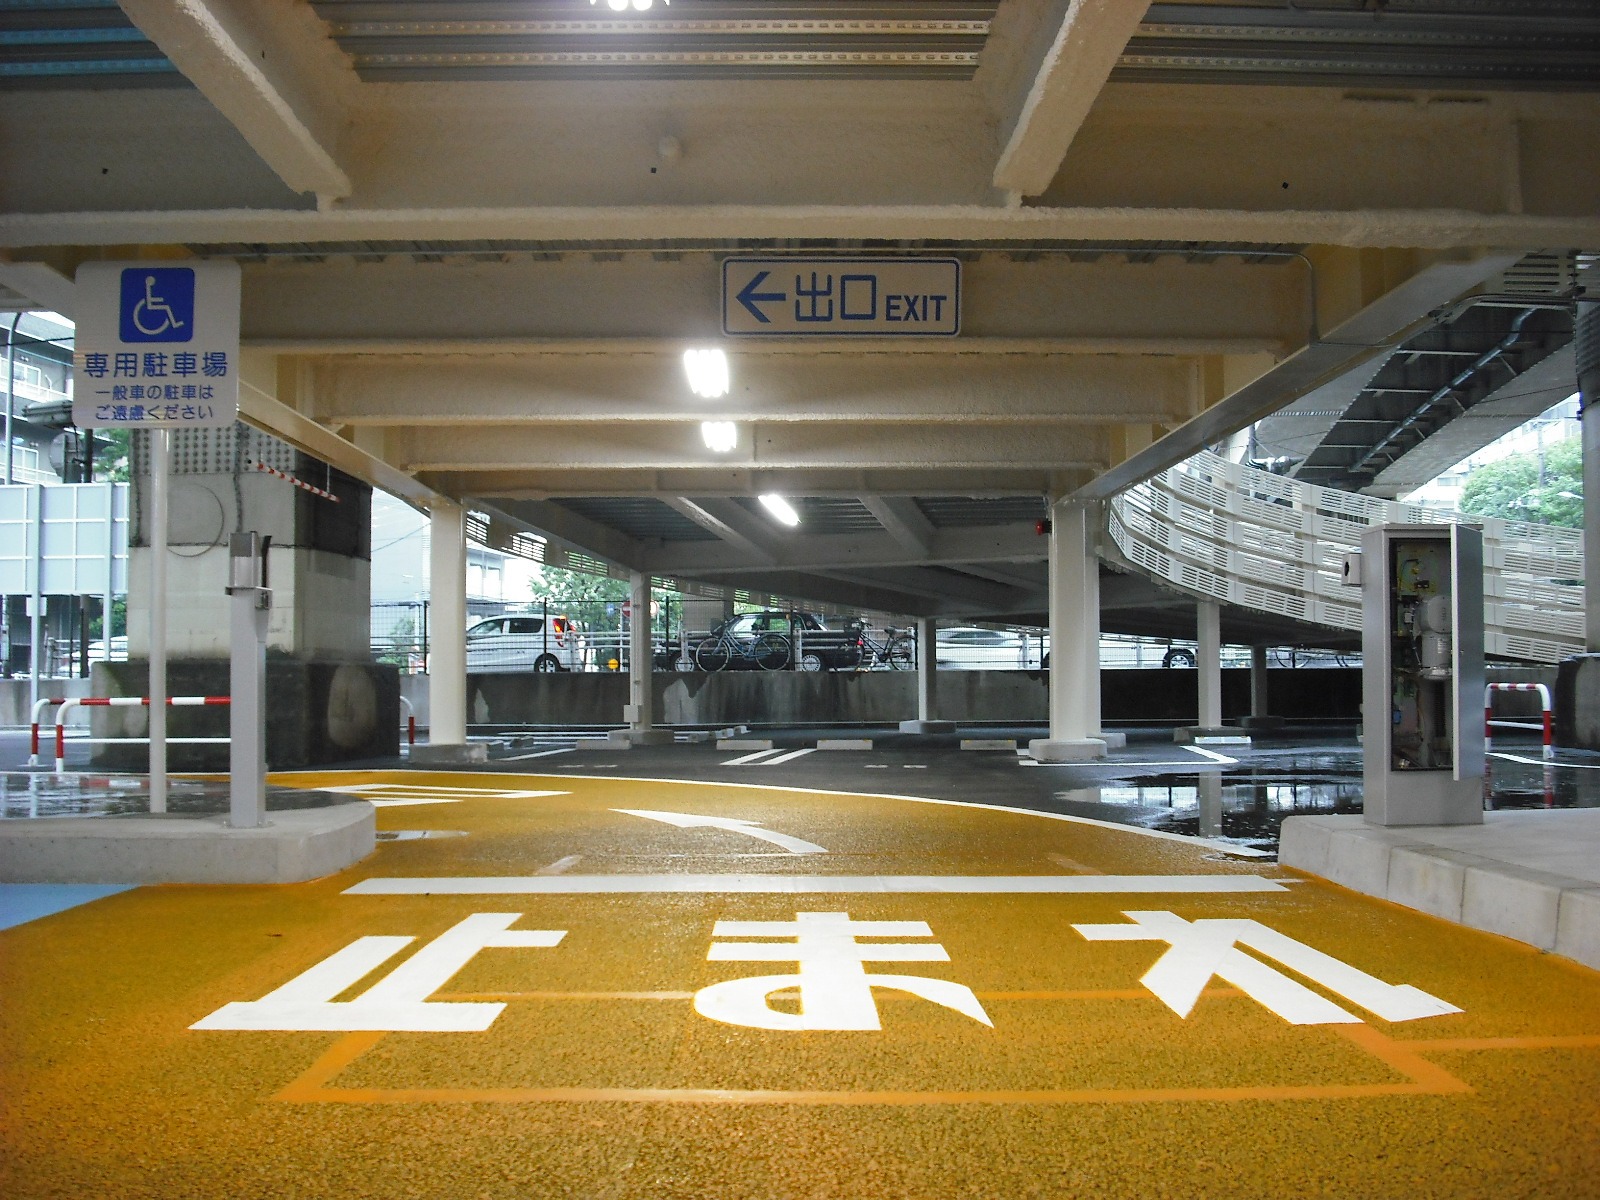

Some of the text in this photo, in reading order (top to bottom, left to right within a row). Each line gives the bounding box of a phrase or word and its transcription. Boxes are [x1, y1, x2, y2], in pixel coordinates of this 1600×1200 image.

[795, 271, 947, 322] 出口 EXIT
[84, 351, 228, 378] 専用駐車場
[95, 385, 214, 401] 一般車の駐車は
[95, 405, 213, 420] ご遠慮ください
[188, 910, 1466, 1032] 止まれ
